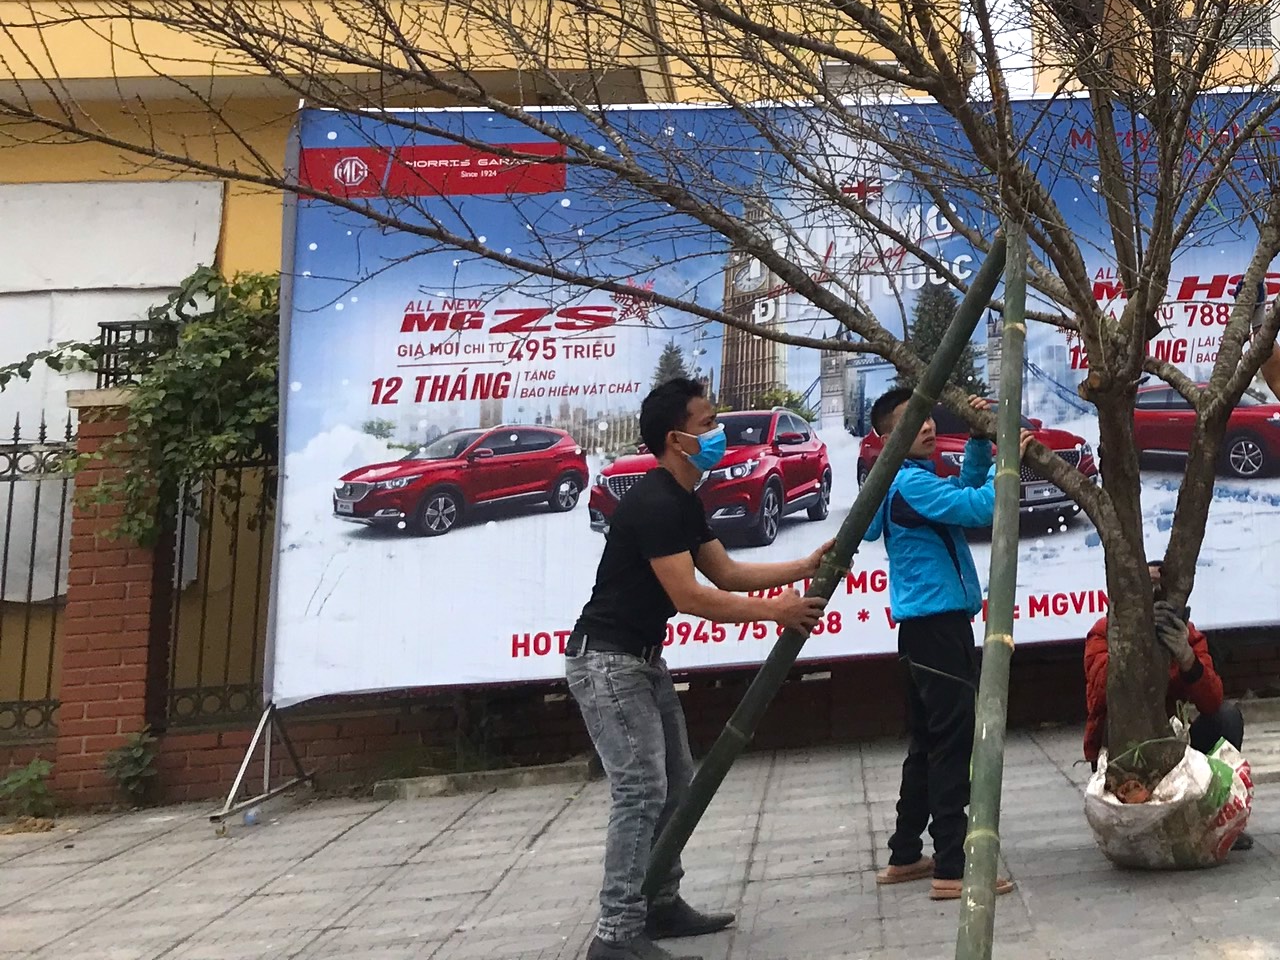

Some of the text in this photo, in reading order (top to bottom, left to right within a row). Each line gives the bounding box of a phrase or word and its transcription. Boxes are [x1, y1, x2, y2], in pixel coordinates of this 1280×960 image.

[405, 159, 470, 168] MORRIS
[477, 157, 541, 167] GARA
[461, 169, 497, 178] Since 1924
[1095, 267, 1119, 280] AL
[404, 298, 482, 313] ALL NEW
[1184, 303, 1230, 327] 788
[400, 306, 617, 334] MG ZS
[507, 338, 556, 362] 495
[562, 342, 616, 361] TRIỆU
[371, 368, 513, 405] 12 THÁNG
[847, 569, 888, 595] MG
[1028, 588, 1110, 618] MGVIN
